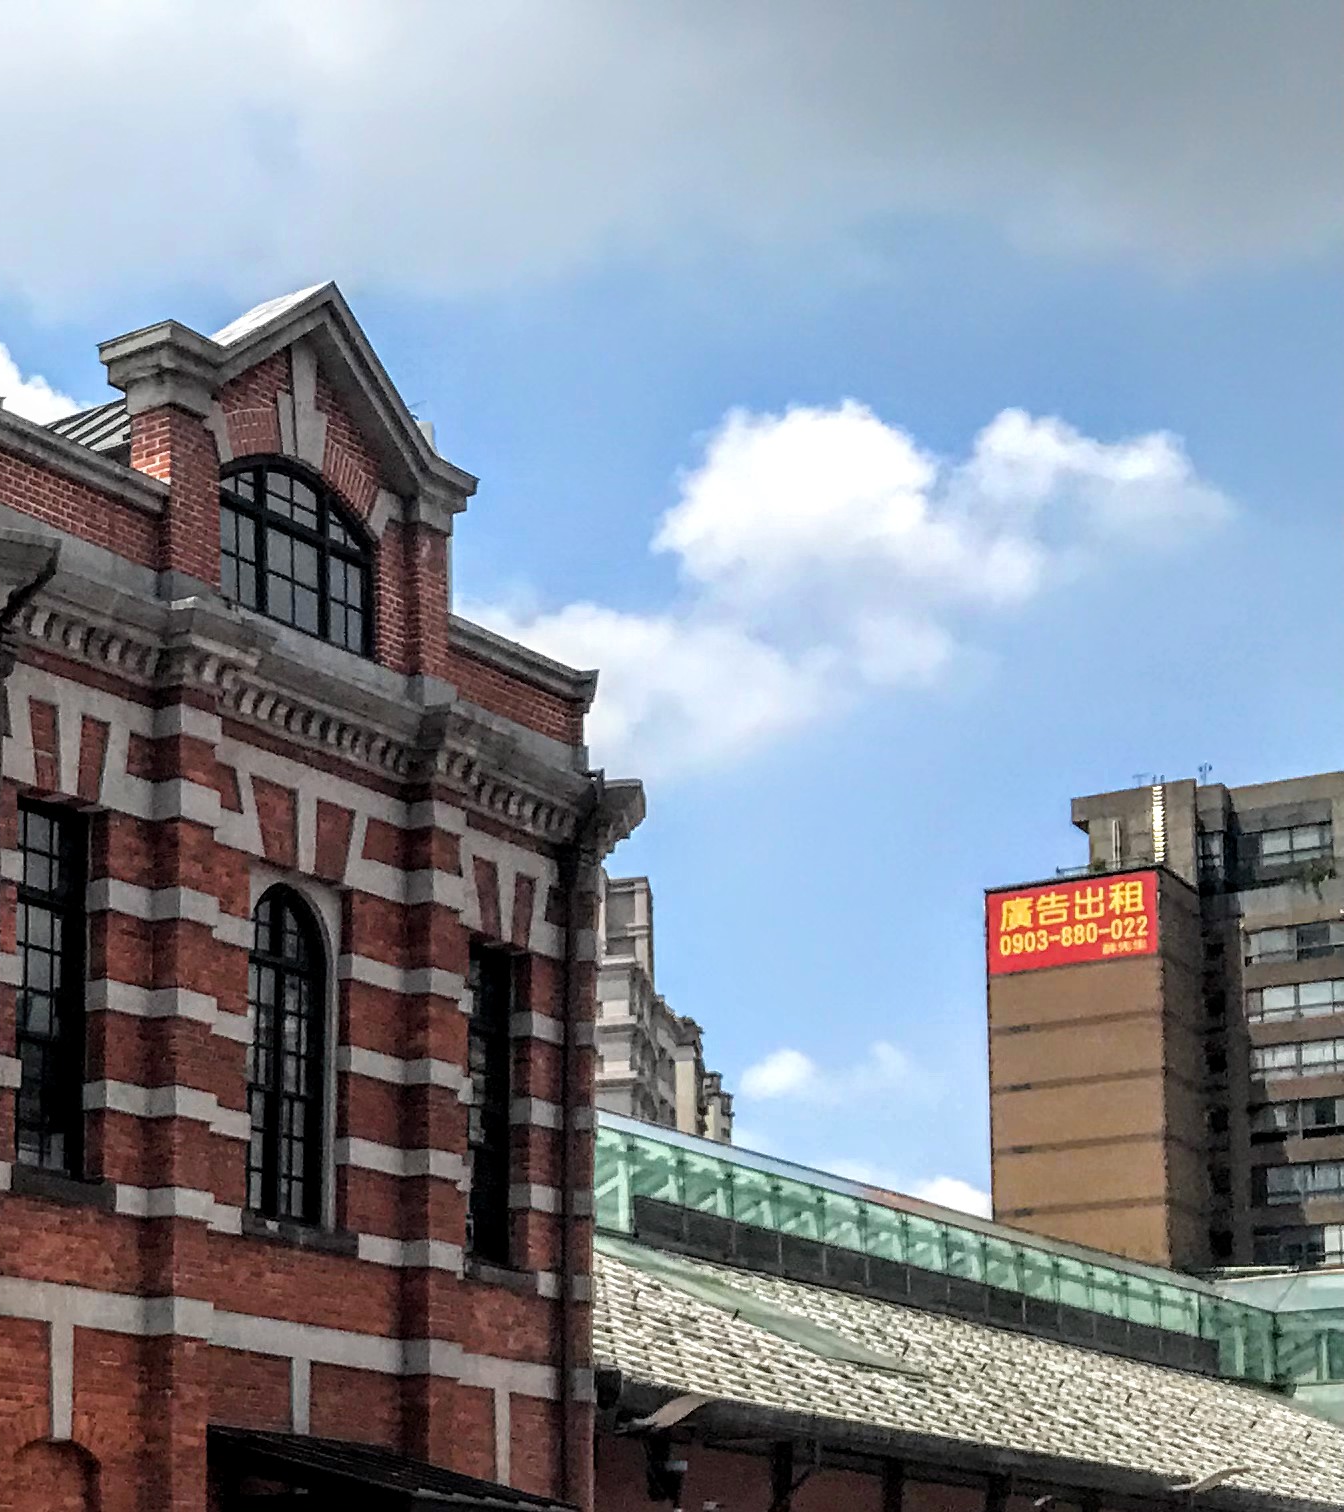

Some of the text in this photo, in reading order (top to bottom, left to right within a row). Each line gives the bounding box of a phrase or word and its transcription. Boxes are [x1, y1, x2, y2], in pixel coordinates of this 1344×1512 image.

[1000, 881, 1145, 932] 廣告出租
[1000, 915, 1148, 956] 0903-880-022
